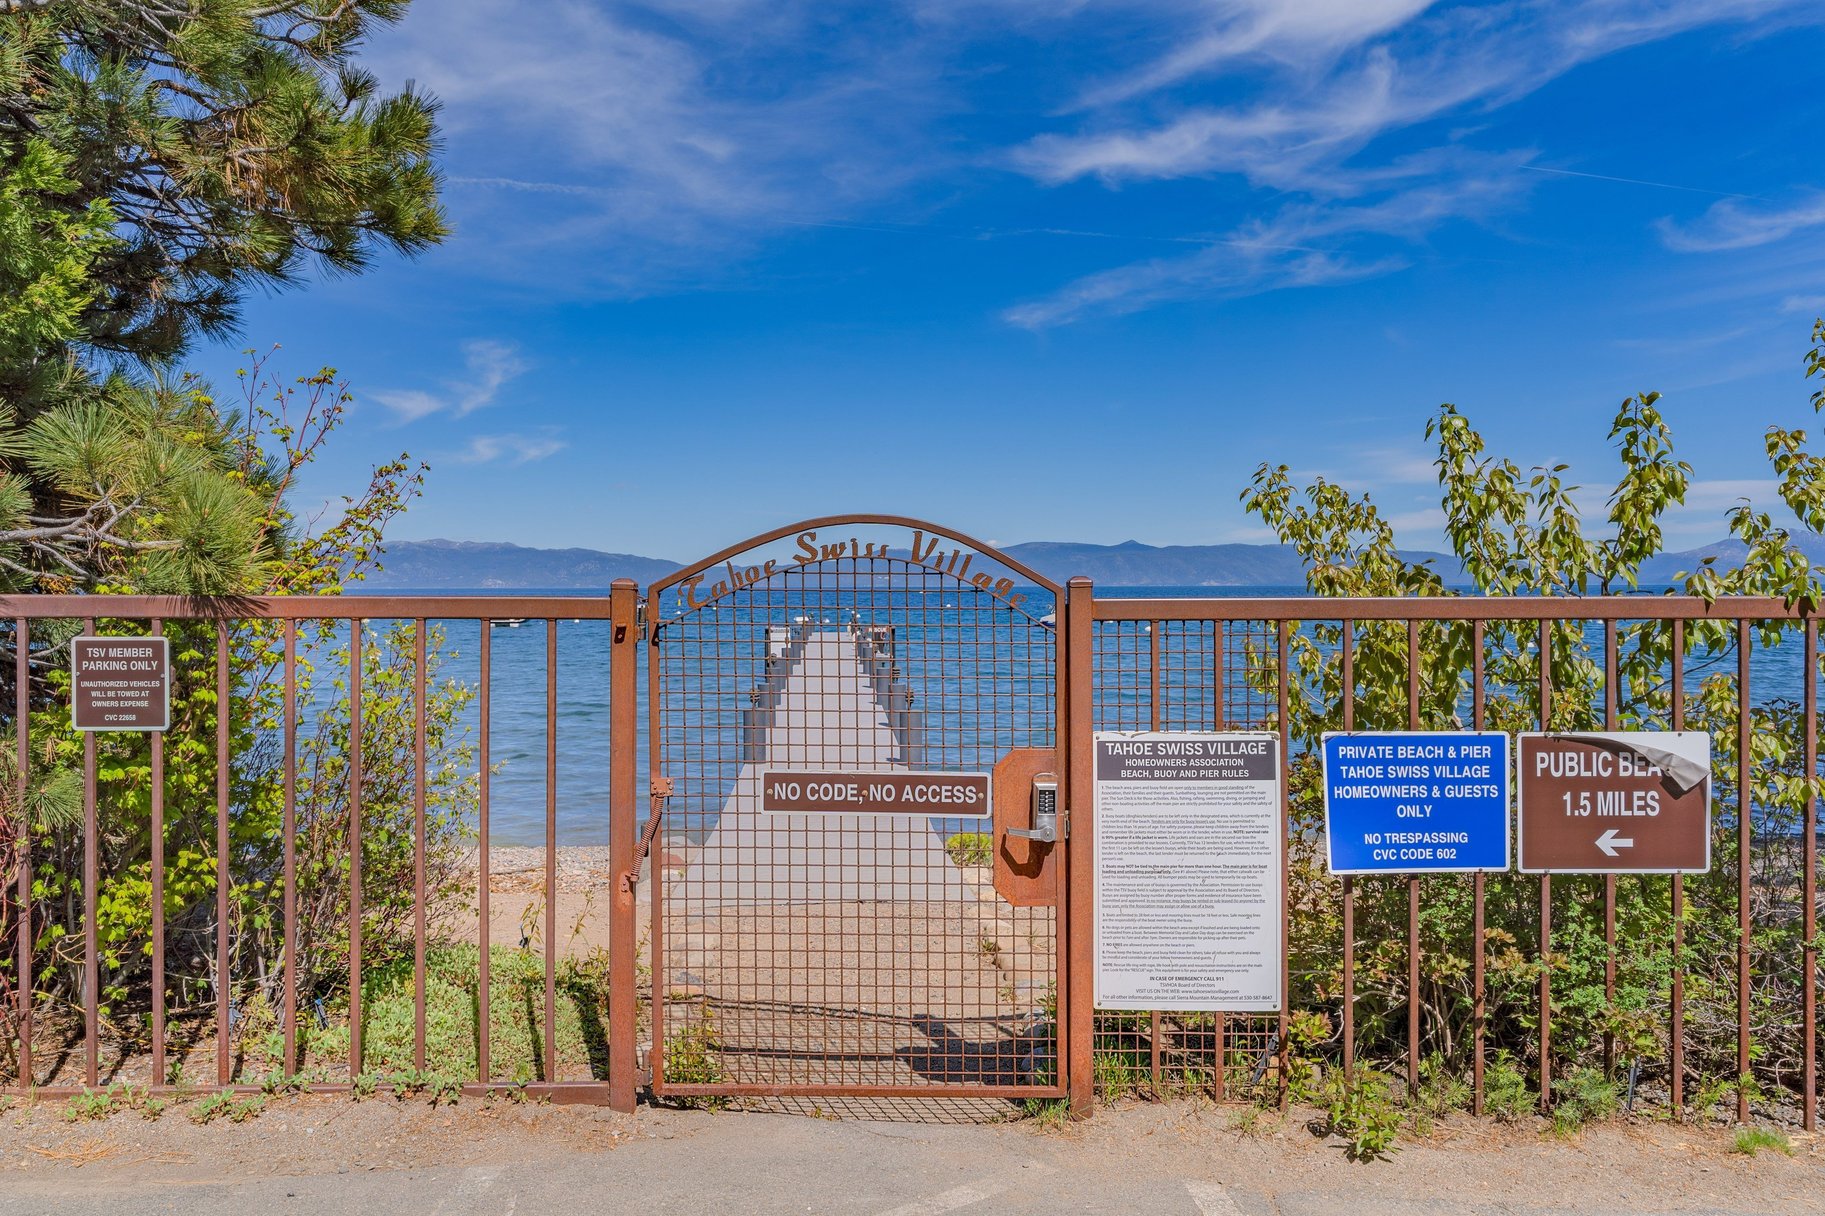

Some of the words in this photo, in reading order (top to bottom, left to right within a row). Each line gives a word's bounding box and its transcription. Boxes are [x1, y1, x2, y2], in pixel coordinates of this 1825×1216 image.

[678, 559, 776, 610] Tahoe
[792, 532, 889, 565] Swiss
[912, 530, 1028, 608] Village
[86, 648, 106, 657] TSV
[109, 648, 152, 657] MEMBER
[82, 661, 127, 670] PARKING
[130, 661, 158, 670] ONLY
[1106, 743, 1152, 755] TAHOE
[1157, 742, 1202, 755] SWISS
[1207, 742, 1266, 755] VILLAGE
[1338, 746, 1393, 758] PRIVATE
[1398, 746, 1443, 758] BEACH
[1448, 746, 1456, 758] &
[1461, 746, 1491, 758] PIER
[1536, 752, 1612, 777] PUBLIC
[1619, 752, 1667, 777] BEA
[1121, 770, 1151, 778] BEACH,
[1340, 766, 1383, 778] TAHOE
[1388, 766, 1430, 778] SWISS
[1434, 766, 1490, 778] VILLAGE
[774, 783, 800, 800] NO
[806, 783, 863, 804] CODE,
[869, 784, 896, 801] NO
[901, 785, 977, 803] ACCESS
[1334, 786, 1428, 798] HOMEOWNERS
[1432, 786, 1440, 798] &
[1444, 785, 1498, 798] GUESTS
[1562, 792, 1591, 816] 1.5
[1597, 790, 1660, 816] MILES
[1396, 805, 1432, 817] ONLY
[1364, 833, 1381, 844] NO
[1384, 832, 1468, 844] TRESPASSING
[1373, 849, 1397, 860] CVC
[1400, 849, 1433, 860] CODE
[1436, 848, 1456, 859] 602
